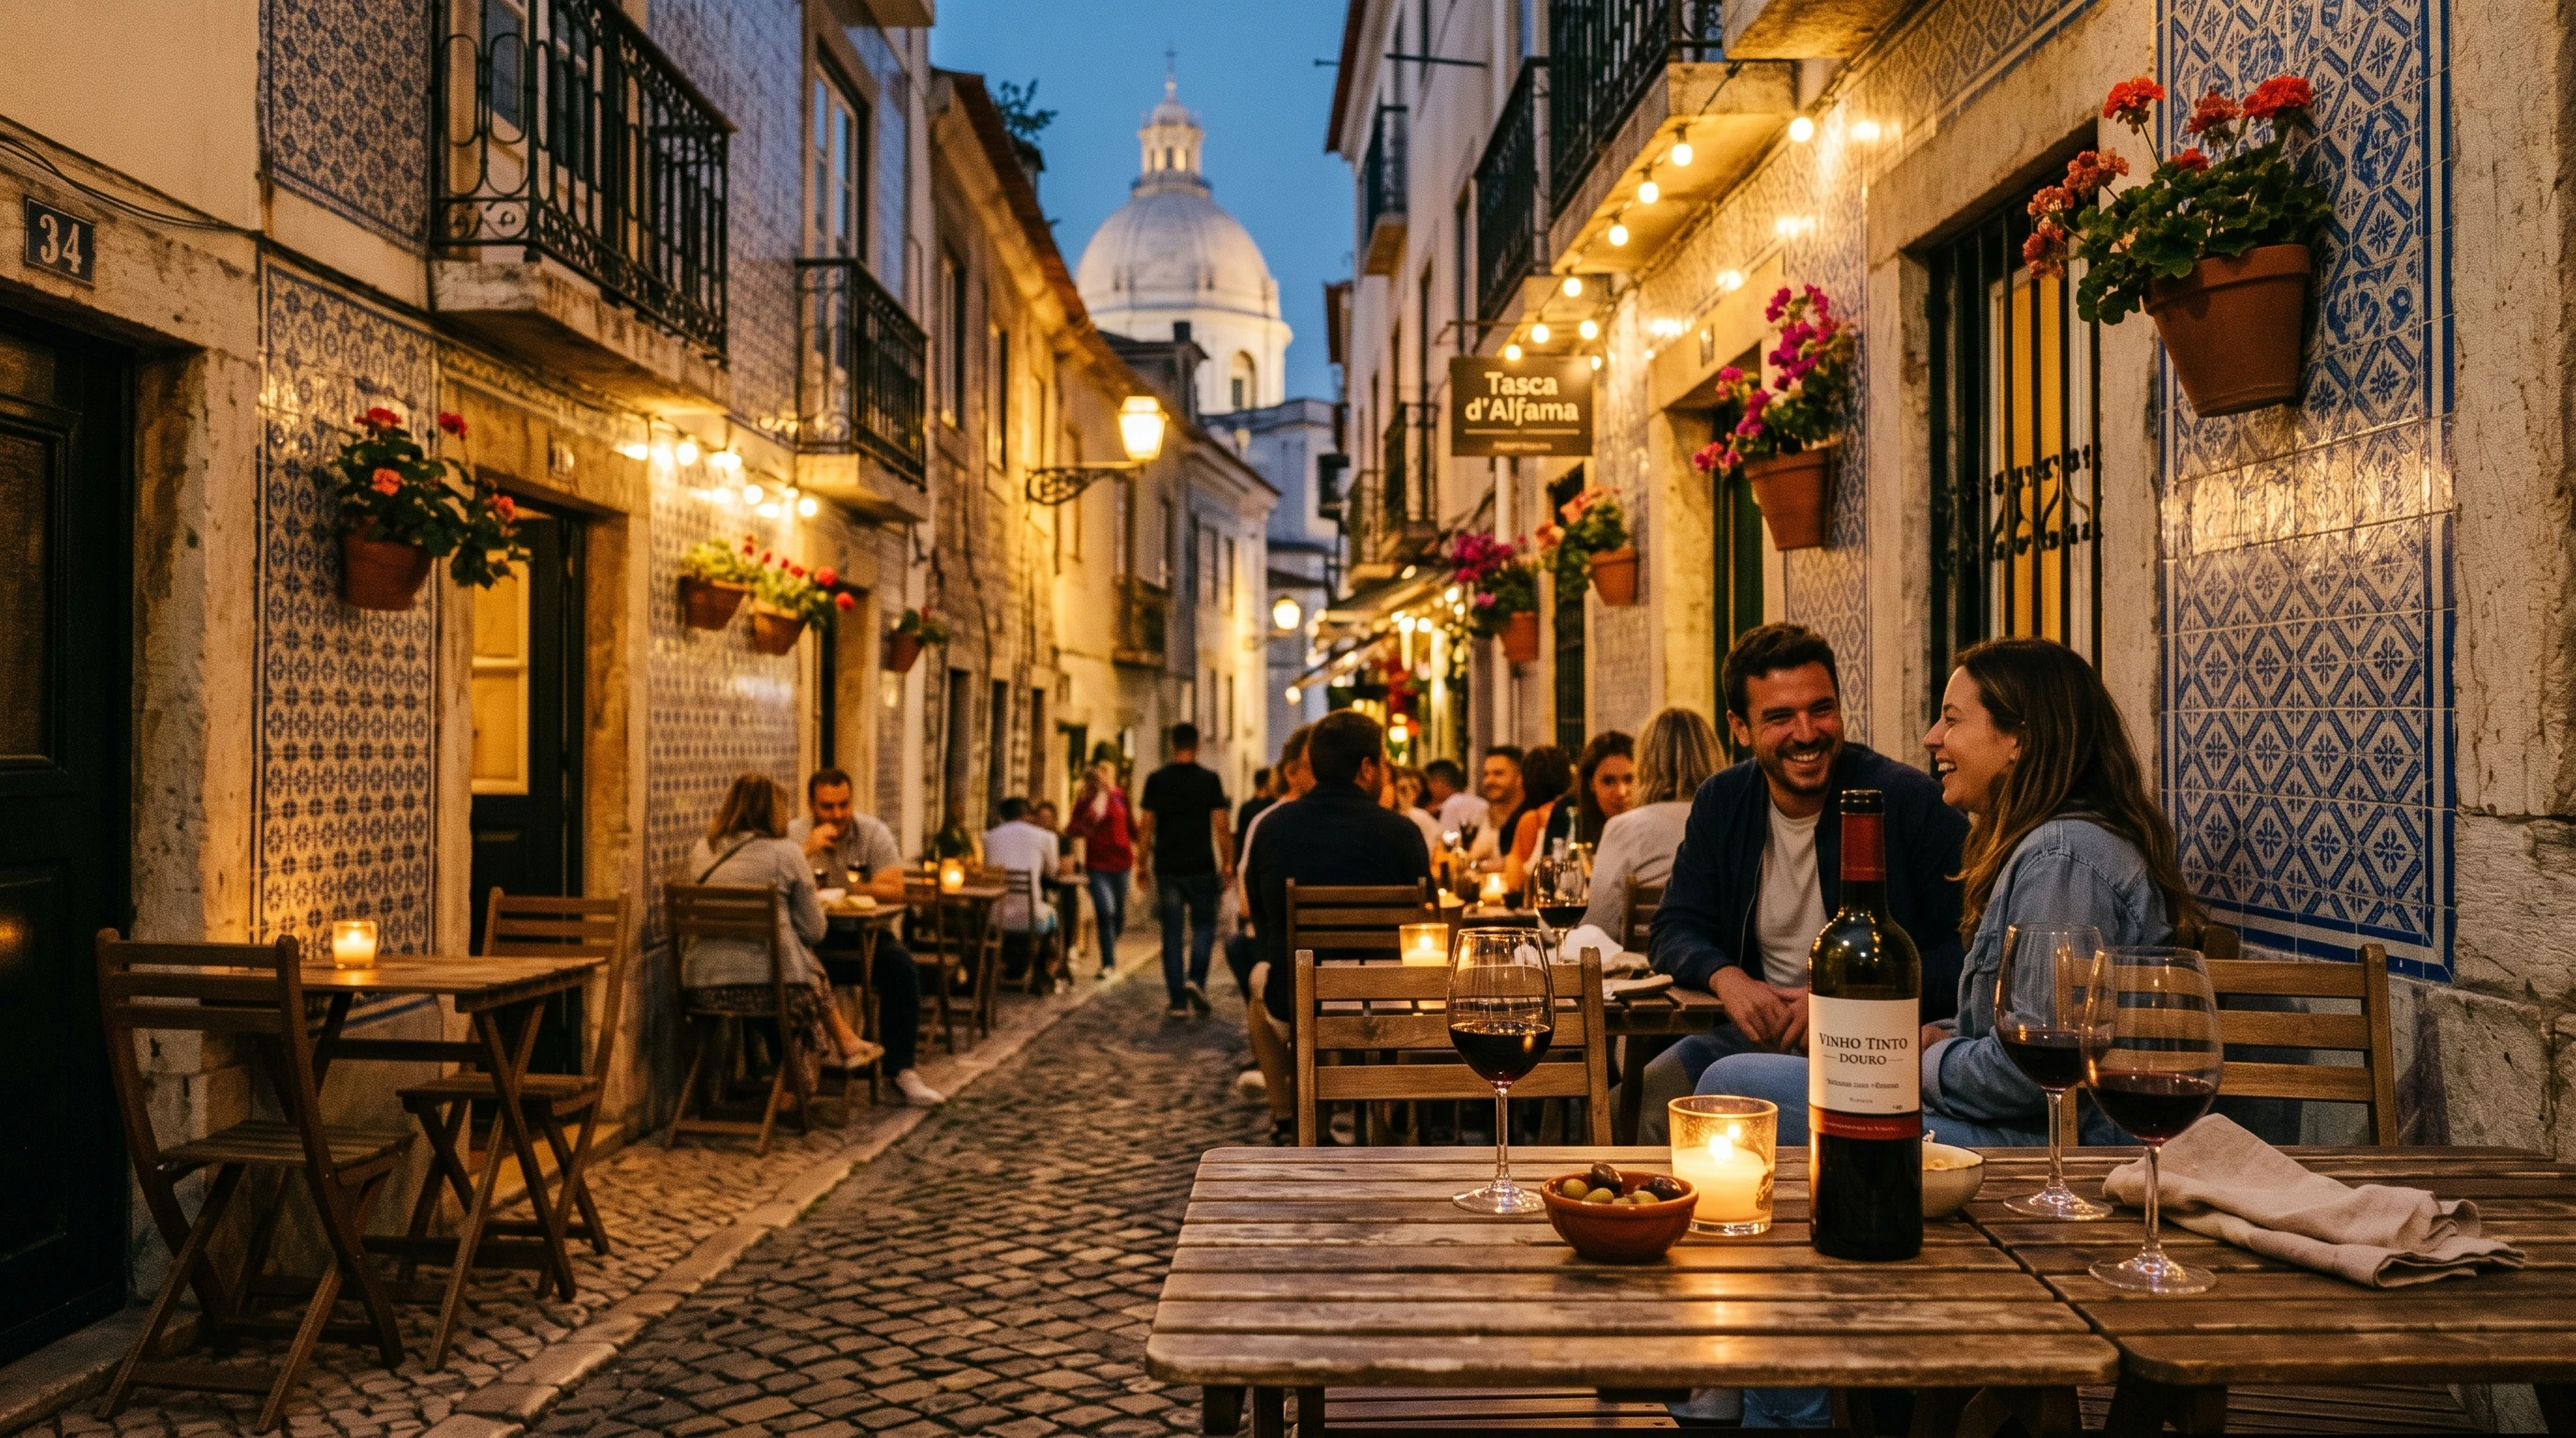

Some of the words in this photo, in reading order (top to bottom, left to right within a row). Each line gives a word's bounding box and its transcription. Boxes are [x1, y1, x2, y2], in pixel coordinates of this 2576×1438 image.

[39, 213, 82, 274] 34
[1484, 371, 1559, 396] Tasca
[1465, 396, 1579, 427] d'Alfama
[1819, 1032, 1862, 1049] VINHO
[1865, 1037, 1909, 1050] TINTO
[1839, 1052, 1887, 1065] DOURO
